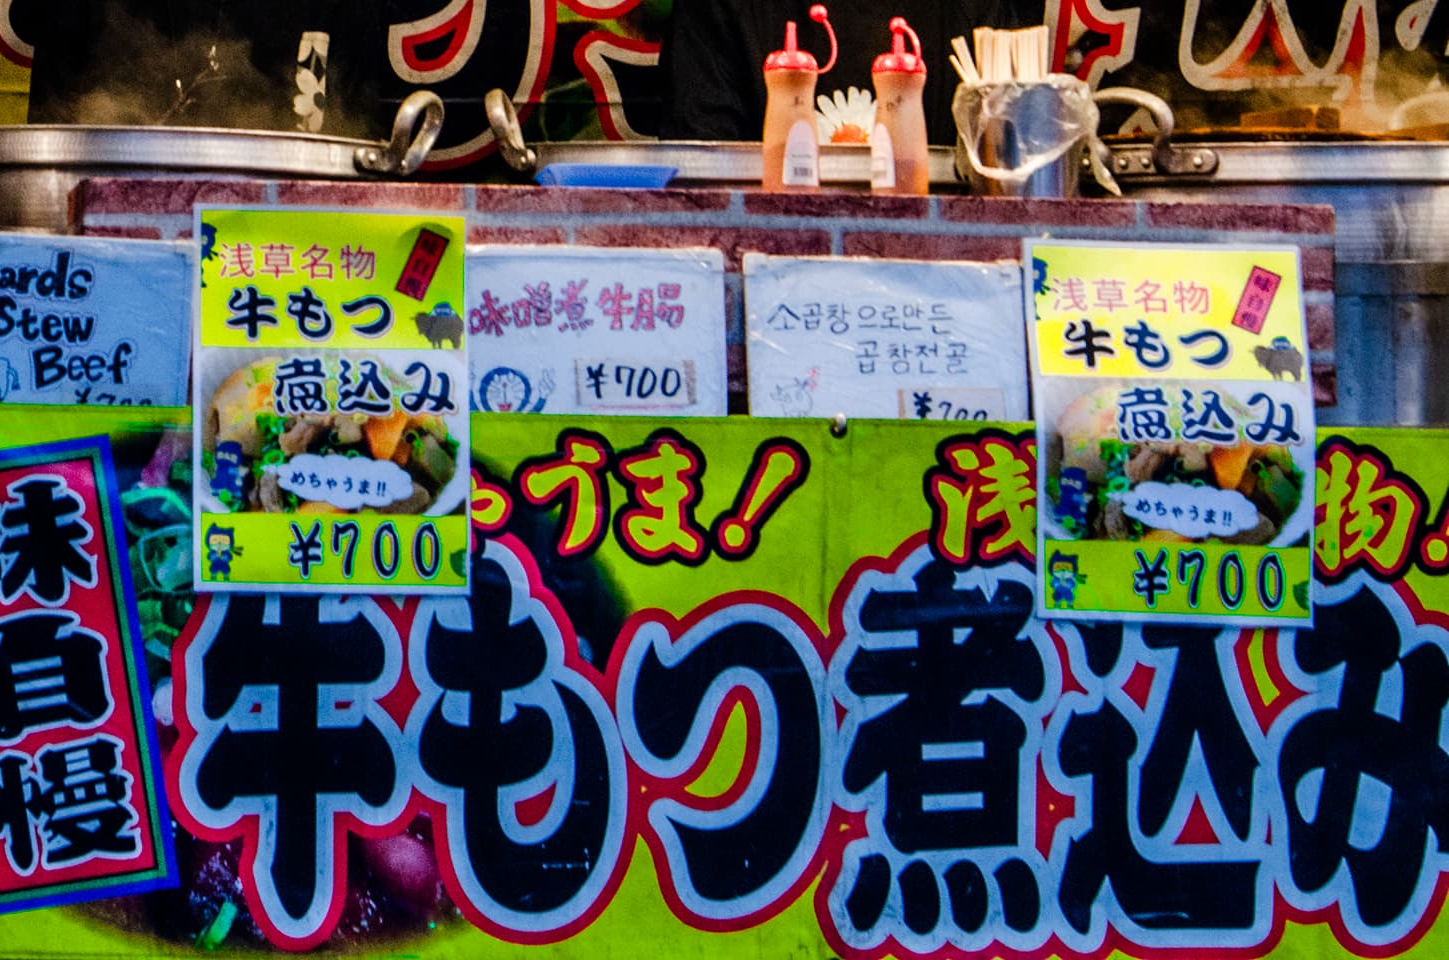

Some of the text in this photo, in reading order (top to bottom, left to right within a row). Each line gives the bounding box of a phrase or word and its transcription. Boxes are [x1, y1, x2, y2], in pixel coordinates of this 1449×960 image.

[219, 243, 376, 281] 浅草名物
[225, 286, 395, 339] 牛もつ
[1053, 277, 1211, 315] 浅草名物
[32, 342, 132, 389] Beef
[1062, 320, 1232, 370] 牛もつ
[273, 358, 456, 415] 煮込み
[586, 362, 681, 399] ¥700
[1116, 386, 1303, 444] 煮込み
[288, 520, 441, 579] ¥700
[1133, 549, 1285, 611] ¥700
[168, 528, 1449, 956] 牛もつ煮込み
